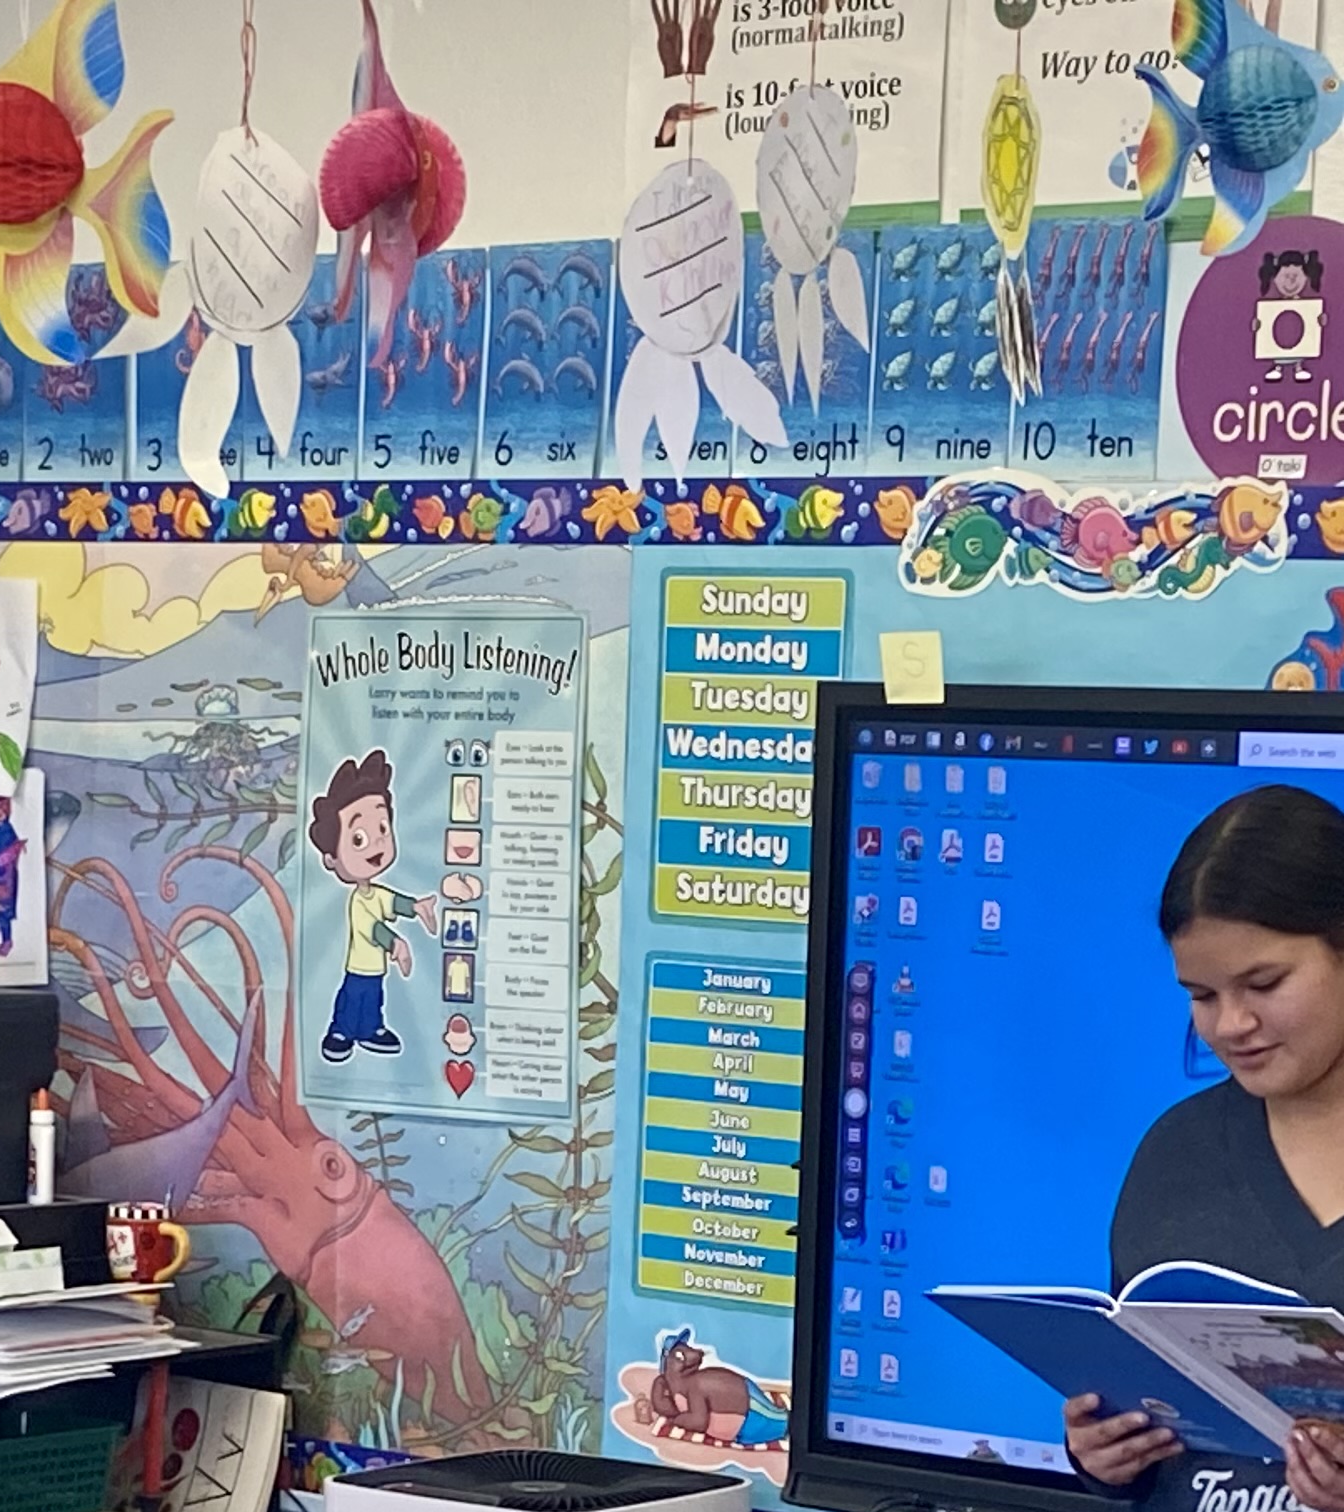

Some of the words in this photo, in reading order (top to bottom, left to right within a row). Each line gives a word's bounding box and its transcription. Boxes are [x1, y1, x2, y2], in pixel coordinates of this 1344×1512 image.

[1041, 50, 1098, 85] Way
[1105, 49, 1131, 75] to
[726, 84, 745, 109] is
[841, 72, 903, 100] voice
[37, 437, 55, 471] 2
[80, 433, 114, 468] two
[146, 438, 163, 472] 3
[256, 434, 275, 469] 4
[299, 433, 349, 468] four
[373, 434, 393, 468] 5
[419, 432, 461, 467] five
[493, 432, 514, 467] 6
[546, 437, 577, 465] six
[793, 423, 860, 478] eight
[886, 424, 905, 463] 9
[936, 425, 991, 459] nine
[1022, 421, 1057, 461] 10
[1086, 421, 1133, 458] ten
[700, 582, 810, 622] Sunday
[315, 640, 390, 689] Whole
[397, 629, 456, 681] Body
[462, 630, 579, 697] Listening!
[694, 632, 808, 670] Monday
[369, 686, 397, 703] Larry
[399, 687, 431, 701] wants
[433, 687, 444, 701] to
[446, 686, 484, 701] remind
[486, 689, 508, 704] you
[509, 688, 520, 701] to
[691, 681, 808, 719] Tuesday
[371, 706, 399, 720] listen
[402, 706, 424, 721] with
[426, 710, 452, 725] your
[454, 708, 485, 722] entire
[487, 708, 516, 726] body
[666, 727, 814, 763] Wednesda
[679, 775, 813, 818] Thursday
[699, 825, 789, 866] Friday
[675, 872, 810, 916] Saturday
[702, 969, 772, 995] January
[697, 996, 774, 1023] February
[708, 1026, 761, 1049] March
[713, 1053, 754, 1074] April
[713, 1079, 750, 1102] May
[709, 1109, 750, 1130] June
[711, 1134, 747, 1159] July
[697, 1160, 758, 1185] August
[681, 1186, 773, 1213] September
[692, 1216, 760, 1242] October
[683, 1242, 766, 1269] November
[683, 1269, 764, 1297] December
